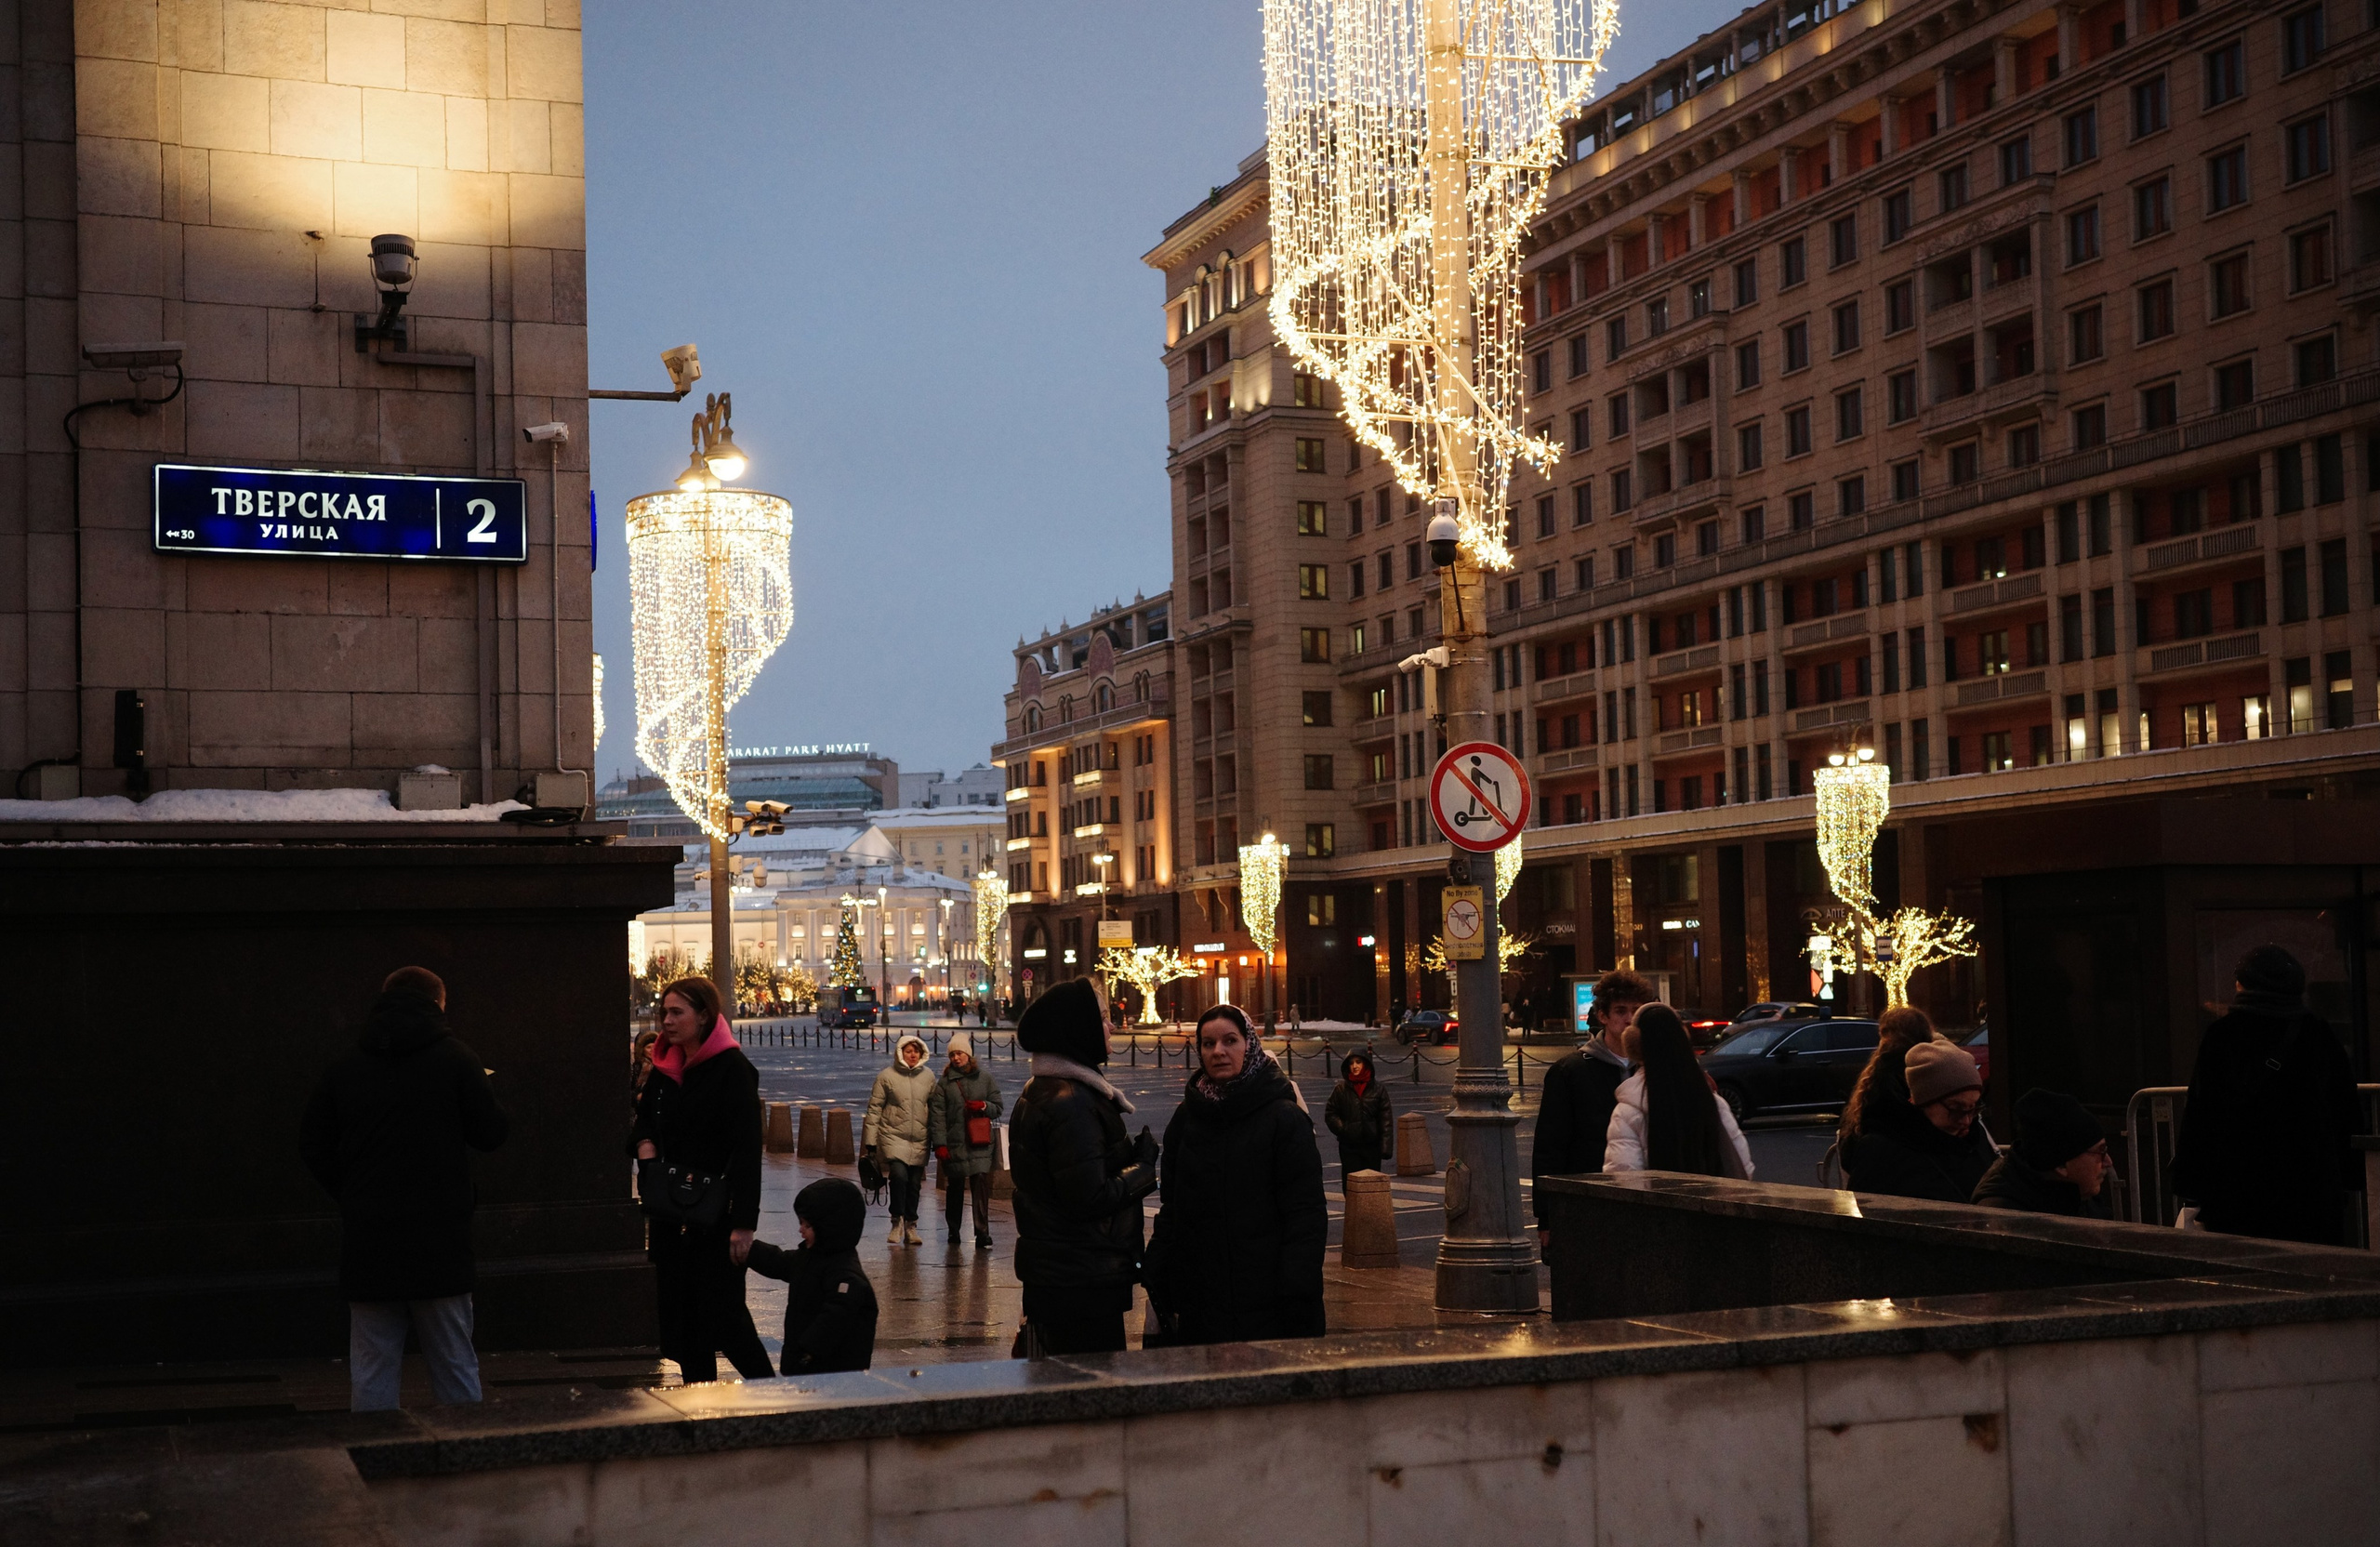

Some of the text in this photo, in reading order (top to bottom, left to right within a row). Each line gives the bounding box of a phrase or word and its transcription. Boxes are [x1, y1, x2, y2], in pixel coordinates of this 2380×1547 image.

[211, 487, 388, 522] ТВЕРСКАЯ
[466, 497, 497, 543] 2
[180, 529, 195, 540] 30
[259, 523, 339, 541] УЛИЦА
[727, 742, 870, 758] ARARAT PARK HYATT
[1455, 890, 1463, 898] fly
